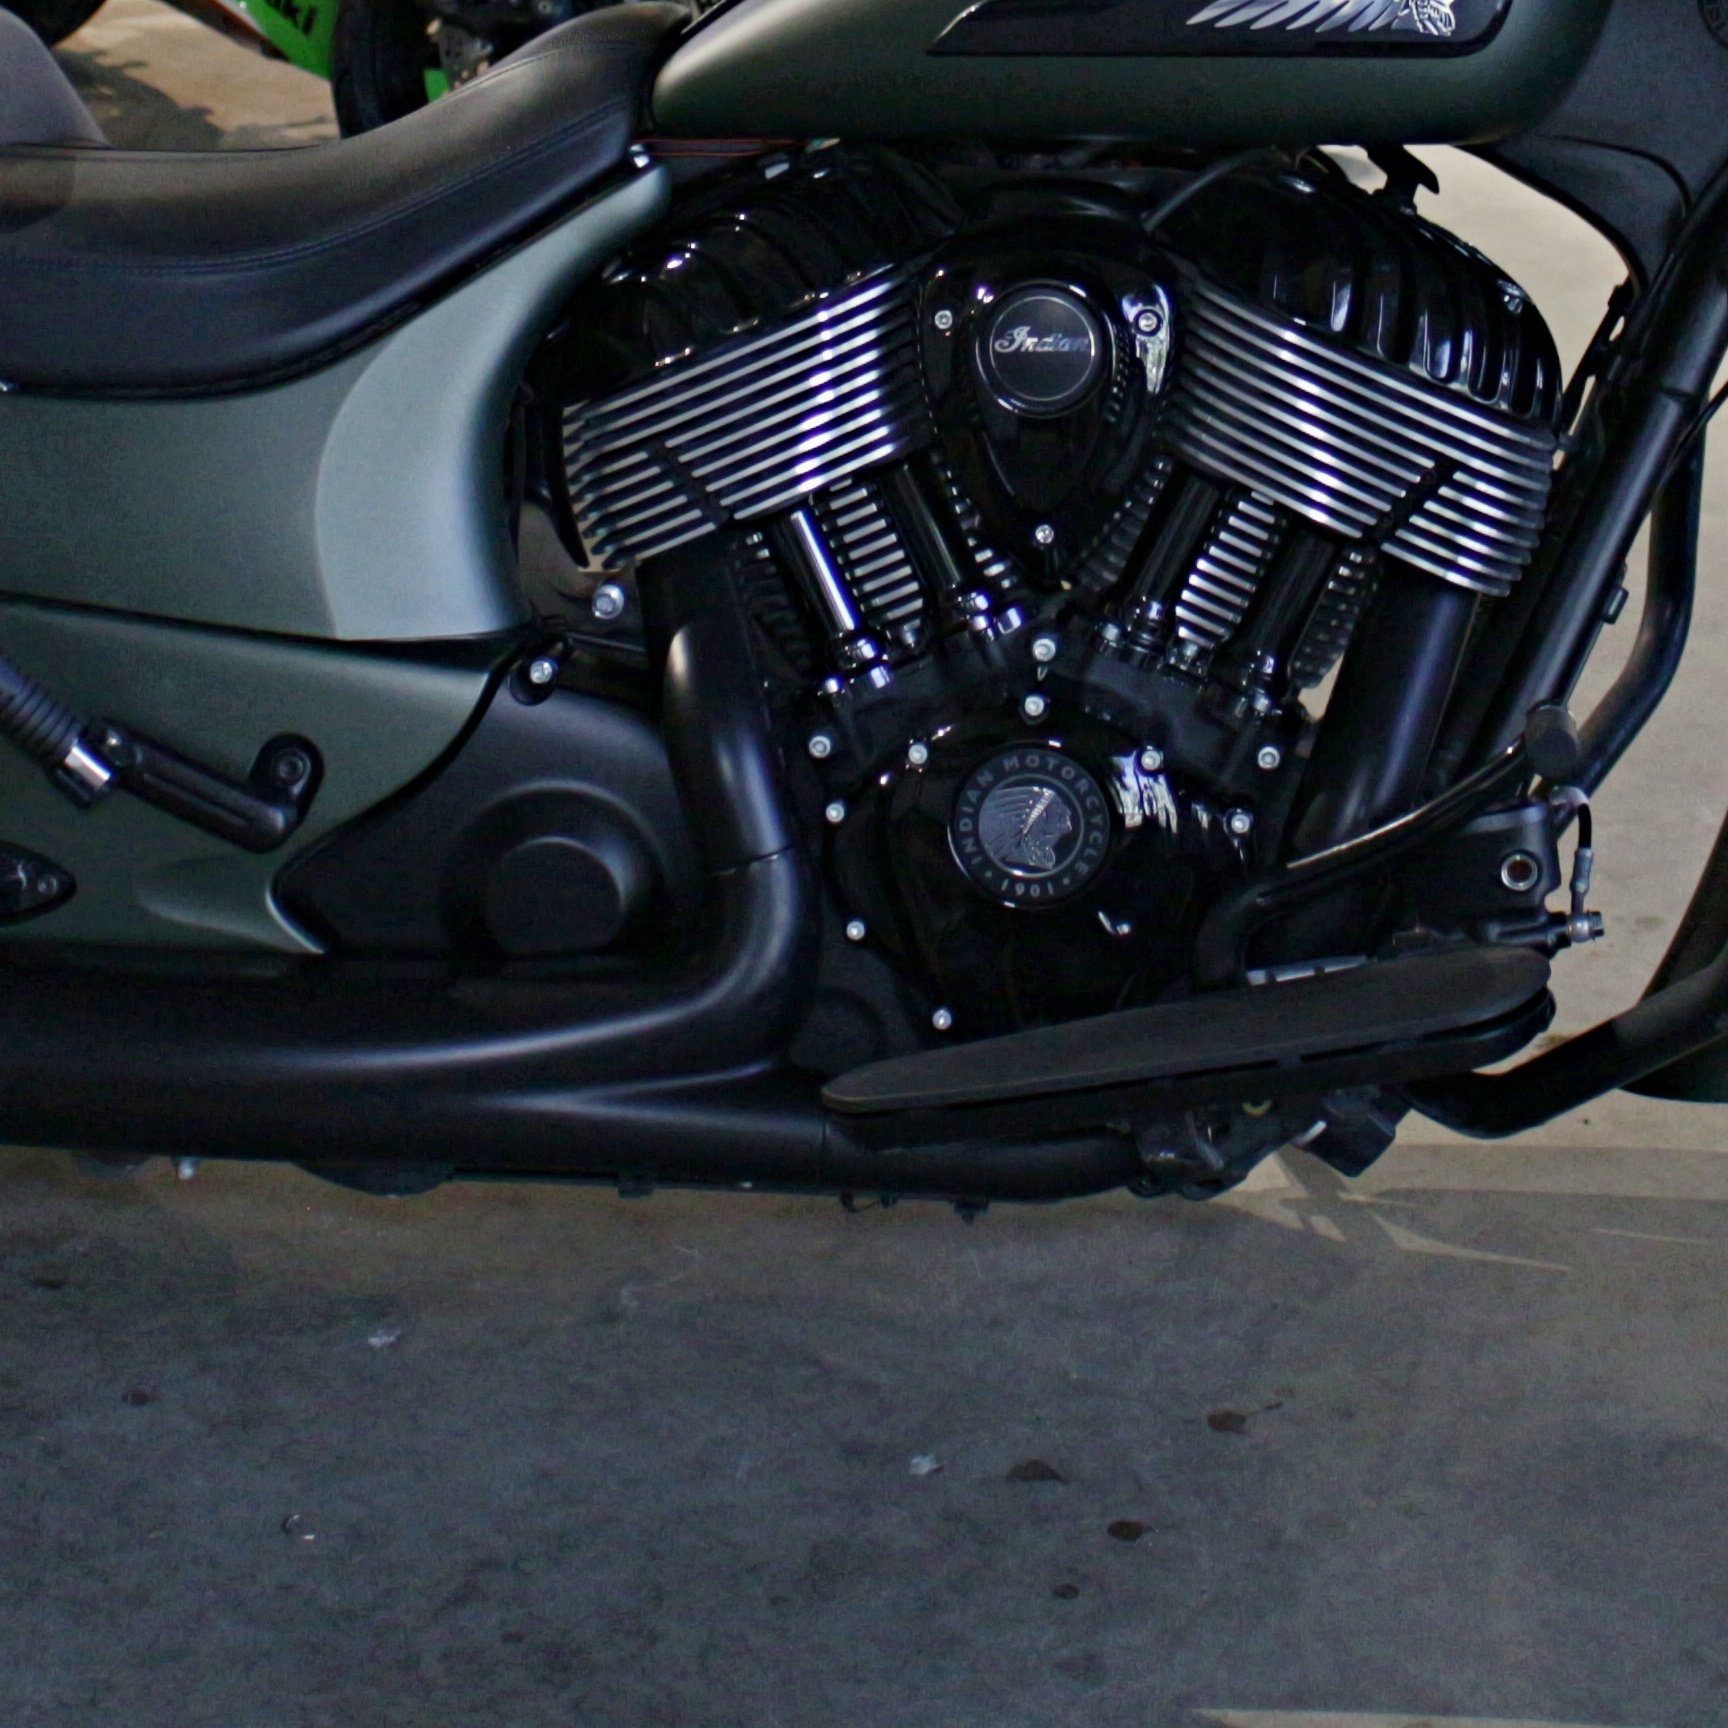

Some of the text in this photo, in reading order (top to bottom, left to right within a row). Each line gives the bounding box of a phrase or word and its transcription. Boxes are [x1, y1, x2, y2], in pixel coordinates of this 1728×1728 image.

[994, 325, 1089, 353] Indian
[959, 753, 1103, 874] INDIAN MOTORCYCLE
[1001, 878, 1055, 898] 1901
